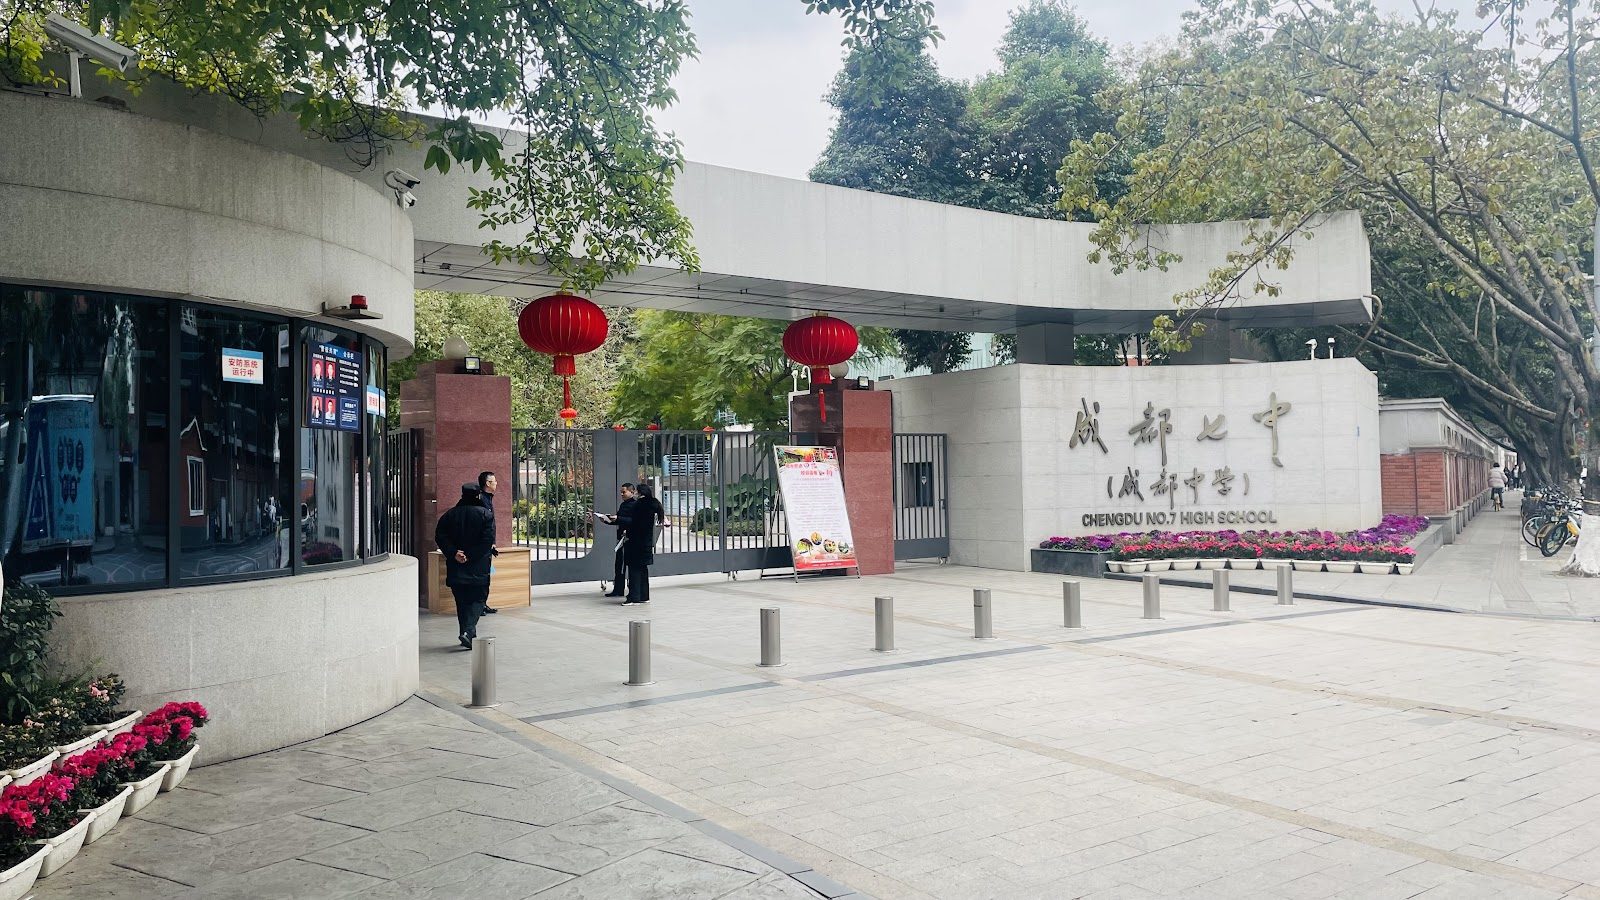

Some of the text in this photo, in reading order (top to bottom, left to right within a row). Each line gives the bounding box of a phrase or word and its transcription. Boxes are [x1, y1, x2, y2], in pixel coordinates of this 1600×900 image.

[229, 358, 258, 368] 安防系统
[232, 367, 254, 377] 运行中
[1069, 391, 1292, 467] 成都七中
[1082, 509, 1277, 527] CHENGDU NO.7 HIGH SCHOOL
